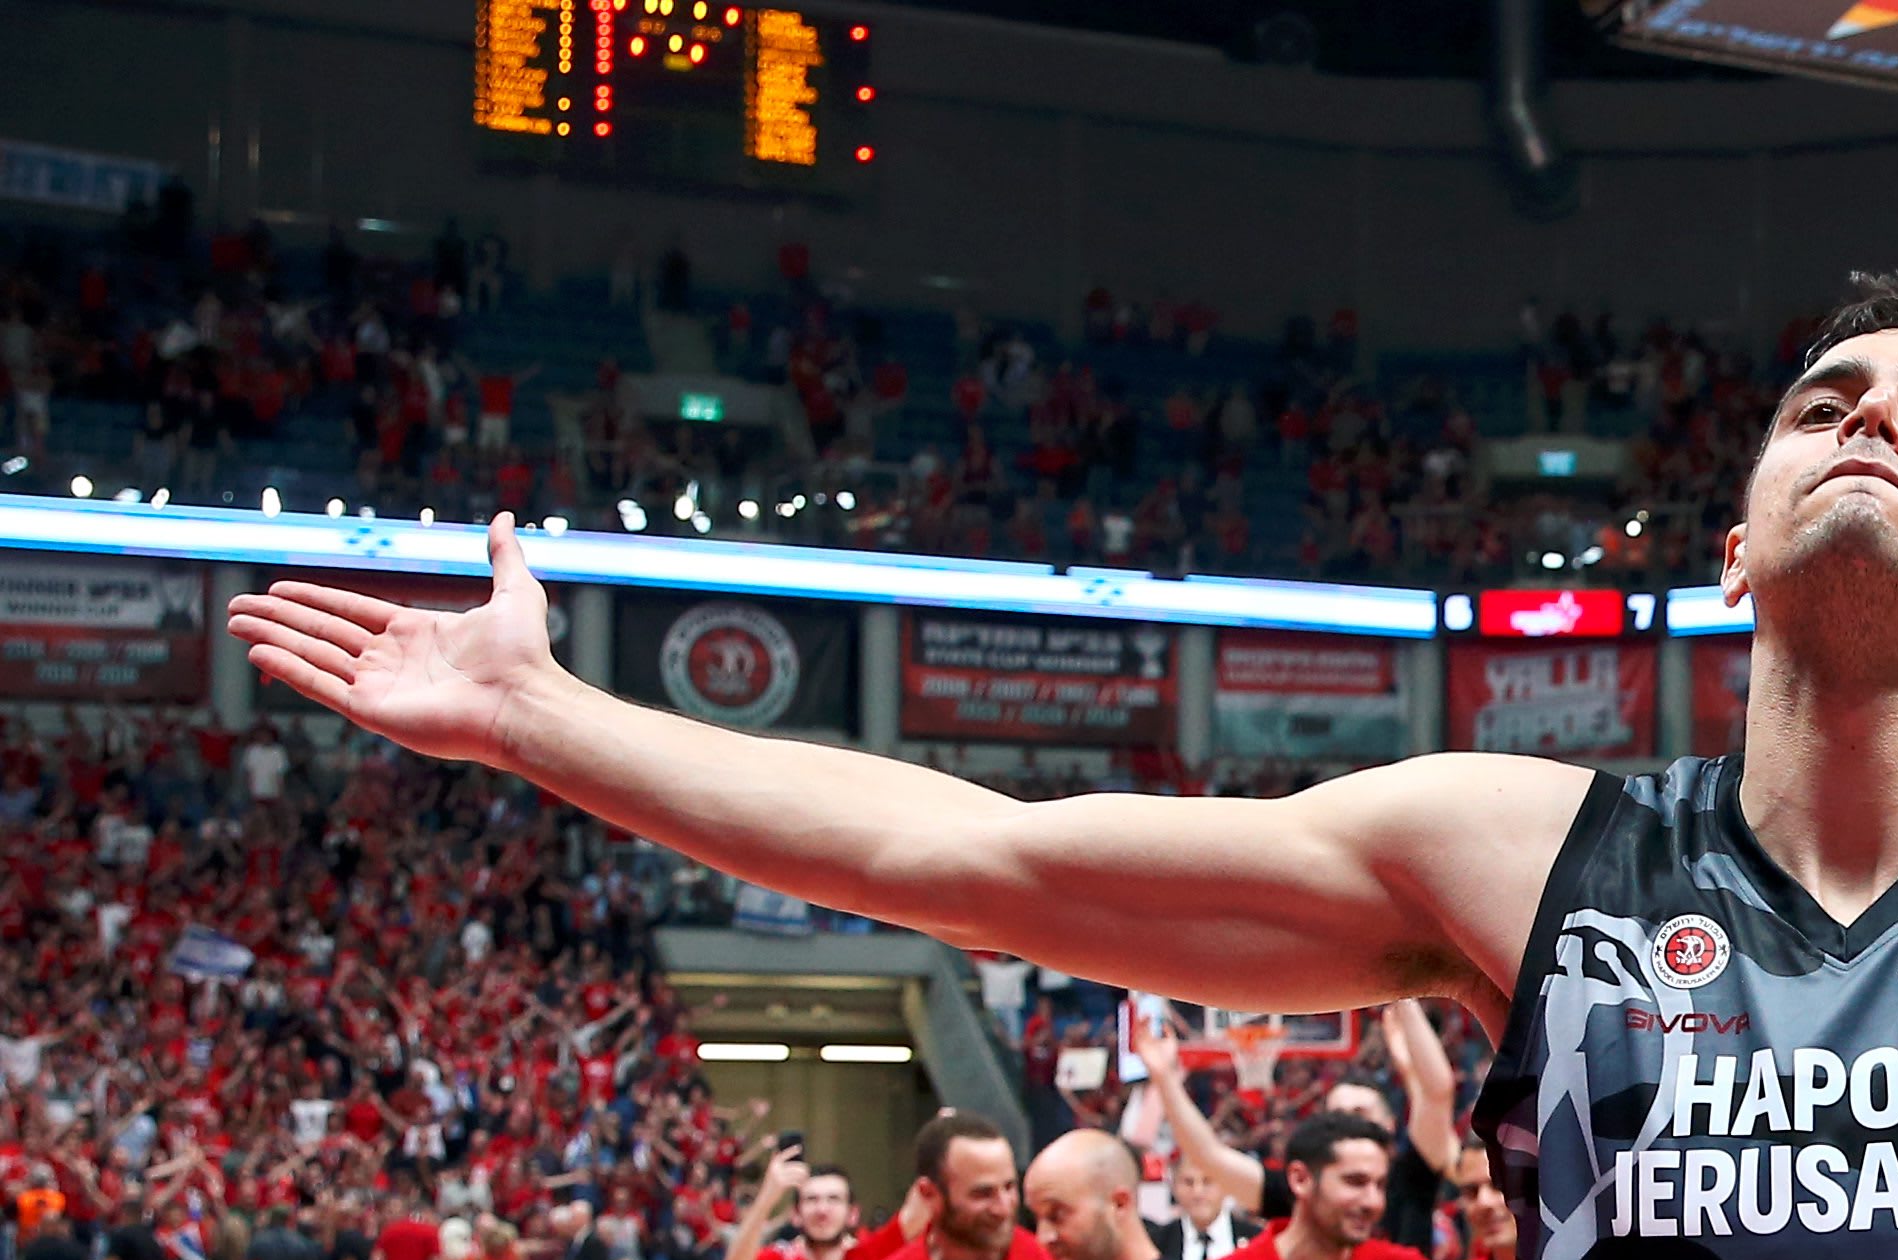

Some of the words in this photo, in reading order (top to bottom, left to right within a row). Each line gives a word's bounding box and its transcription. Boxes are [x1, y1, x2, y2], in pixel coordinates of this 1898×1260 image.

[1627, 594, 1655, 630] 7
[1485, 646, 1618, 702] YALLA
[1660, 917, 1695, 940] ירושלים
[1674, 969, 1716, 985] JERUSALEM
[1626, 1007, 1750, 1034] GIVOVA
